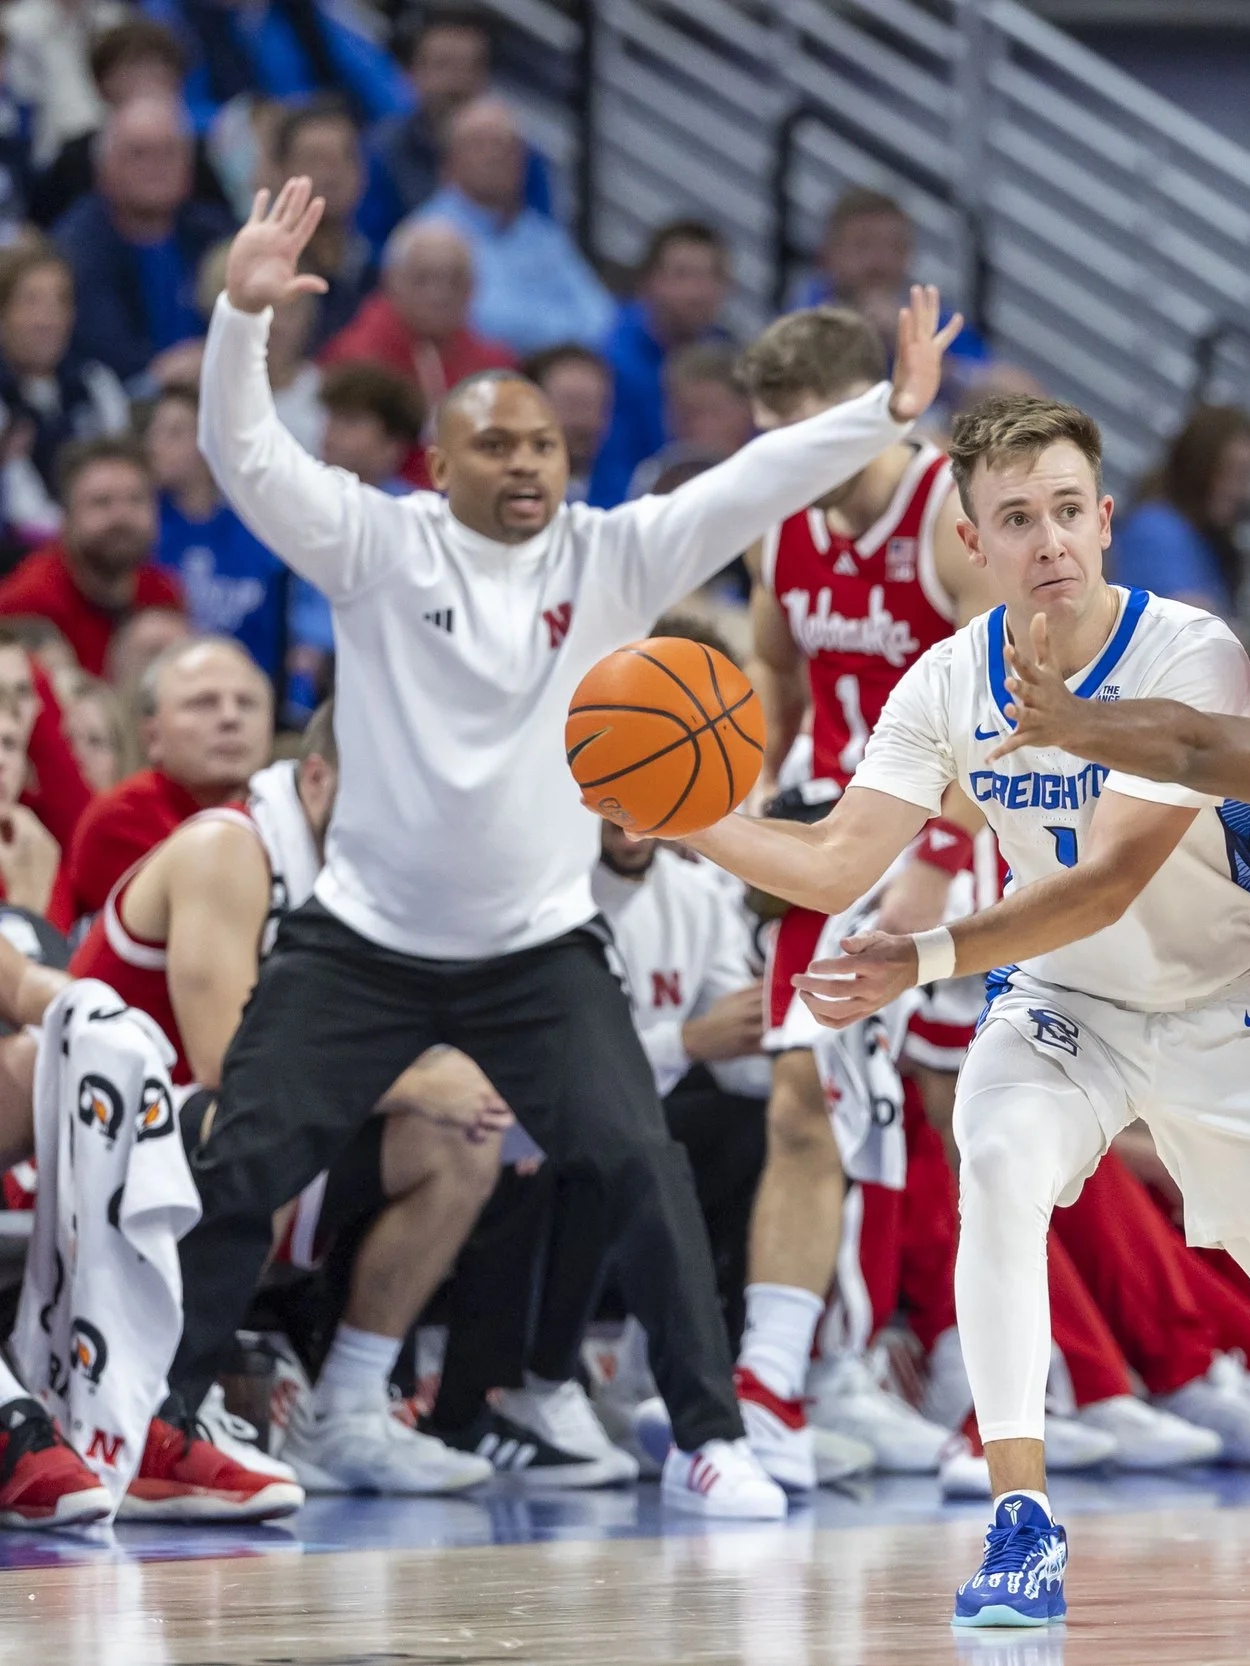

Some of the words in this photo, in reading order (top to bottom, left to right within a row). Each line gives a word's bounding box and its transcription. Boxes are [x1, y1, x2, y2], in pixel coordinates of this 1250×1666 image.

[543, 601, 573, 650] N
[1103, 685, 1120, 695] THE
[834, 673, 870, 772] 1
[969, 763, 1111, 810] CREIGHTO
[1043, 825, 1079, 869] 1
[651, 970, 683, 1008] N
[85, 1428, 126, 1468] N
